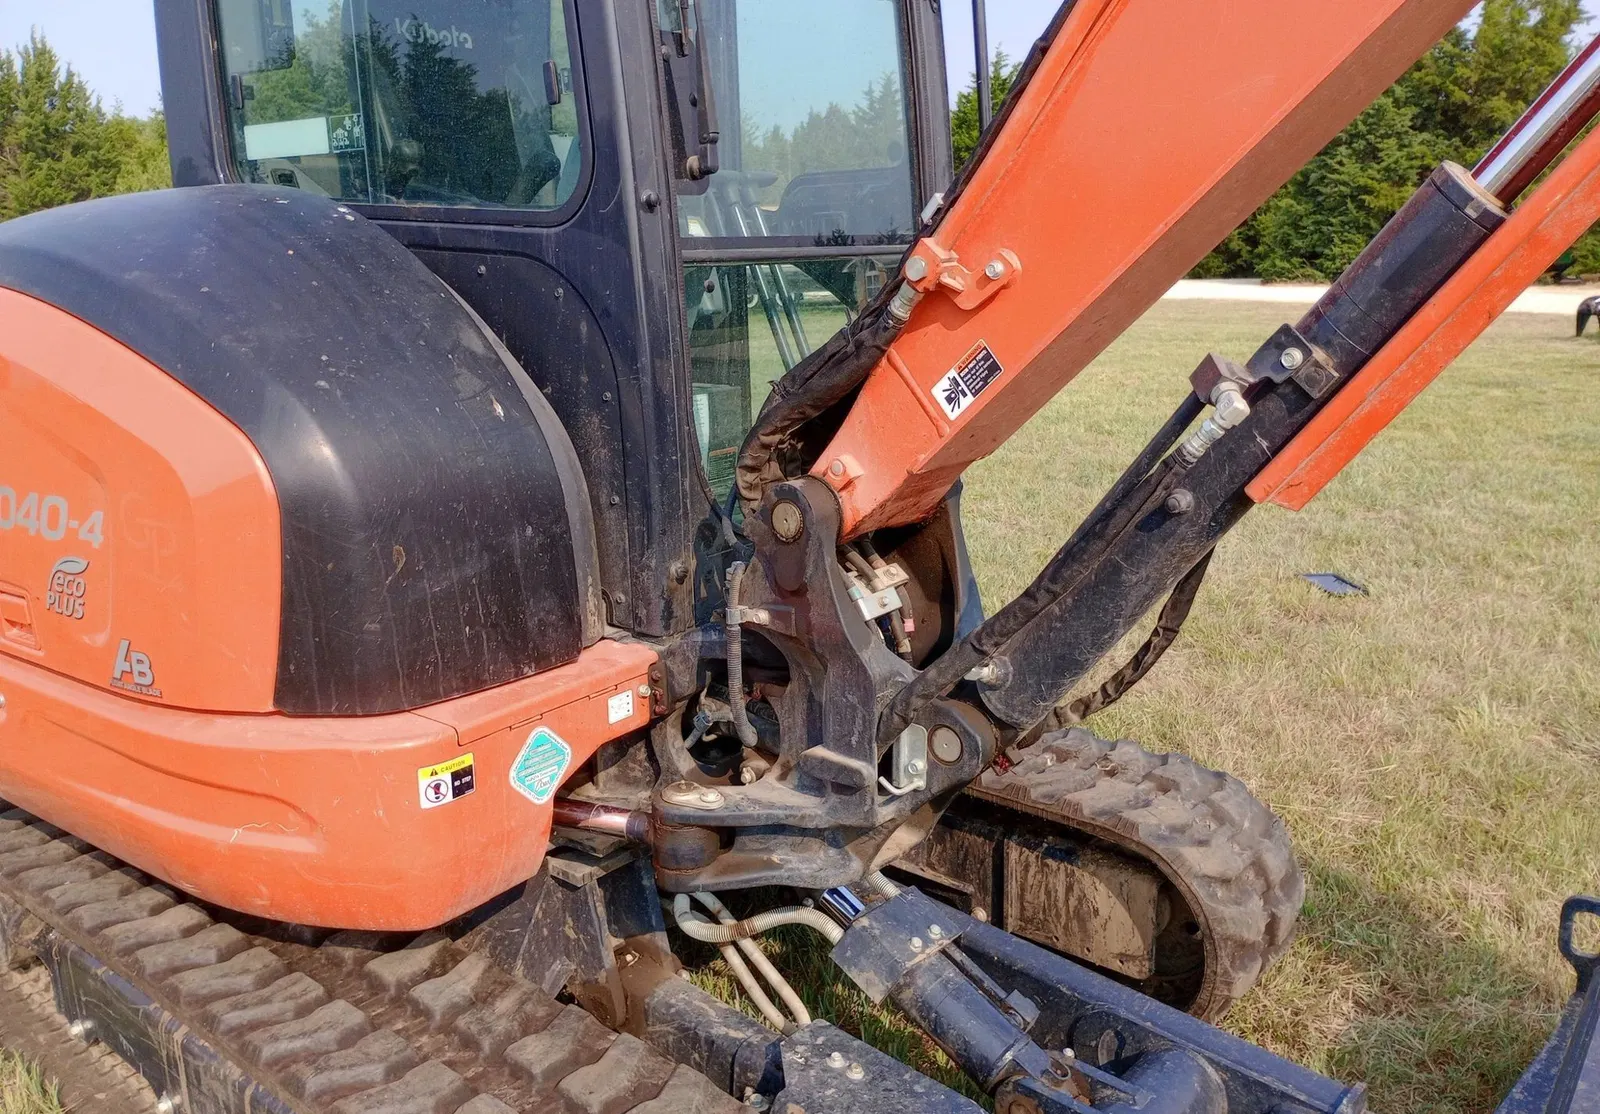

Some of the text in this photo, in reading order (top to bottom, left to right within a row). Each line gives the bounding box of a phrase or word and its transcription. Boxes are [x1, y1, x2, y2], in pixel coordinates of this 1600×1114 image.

[394, 17, 473, 49] Kubota
[961, 343, 981, 365] WARNING
[54, 573, 86, 596] eco
[47, 591, 85, 619] PLUS
[440, 759, 466, 773] CAUTION
[454, 775, 472, 787] NO STEP
